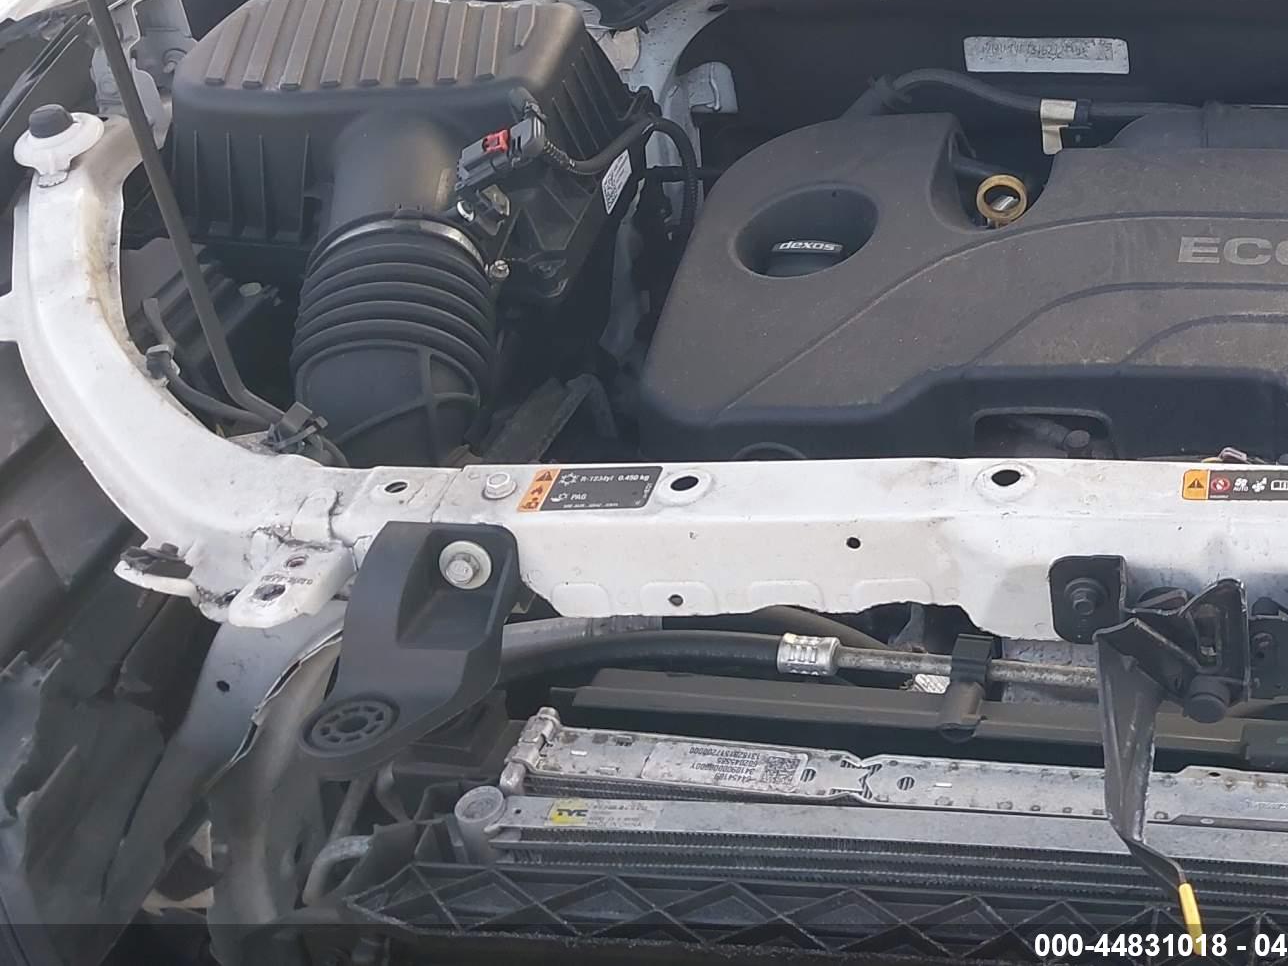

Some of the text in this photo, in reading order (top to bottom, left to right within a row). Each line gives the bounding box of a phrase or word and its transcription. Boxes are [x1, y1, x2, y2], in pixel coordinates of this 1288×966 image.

[779, 240, 835, 251] dexos
[617, 474, 639, 482] 0.450
[639, 474, 650, 482] kg
[570, 493, 587, 501] PAG
[556, 808, 588, 817] TYC
